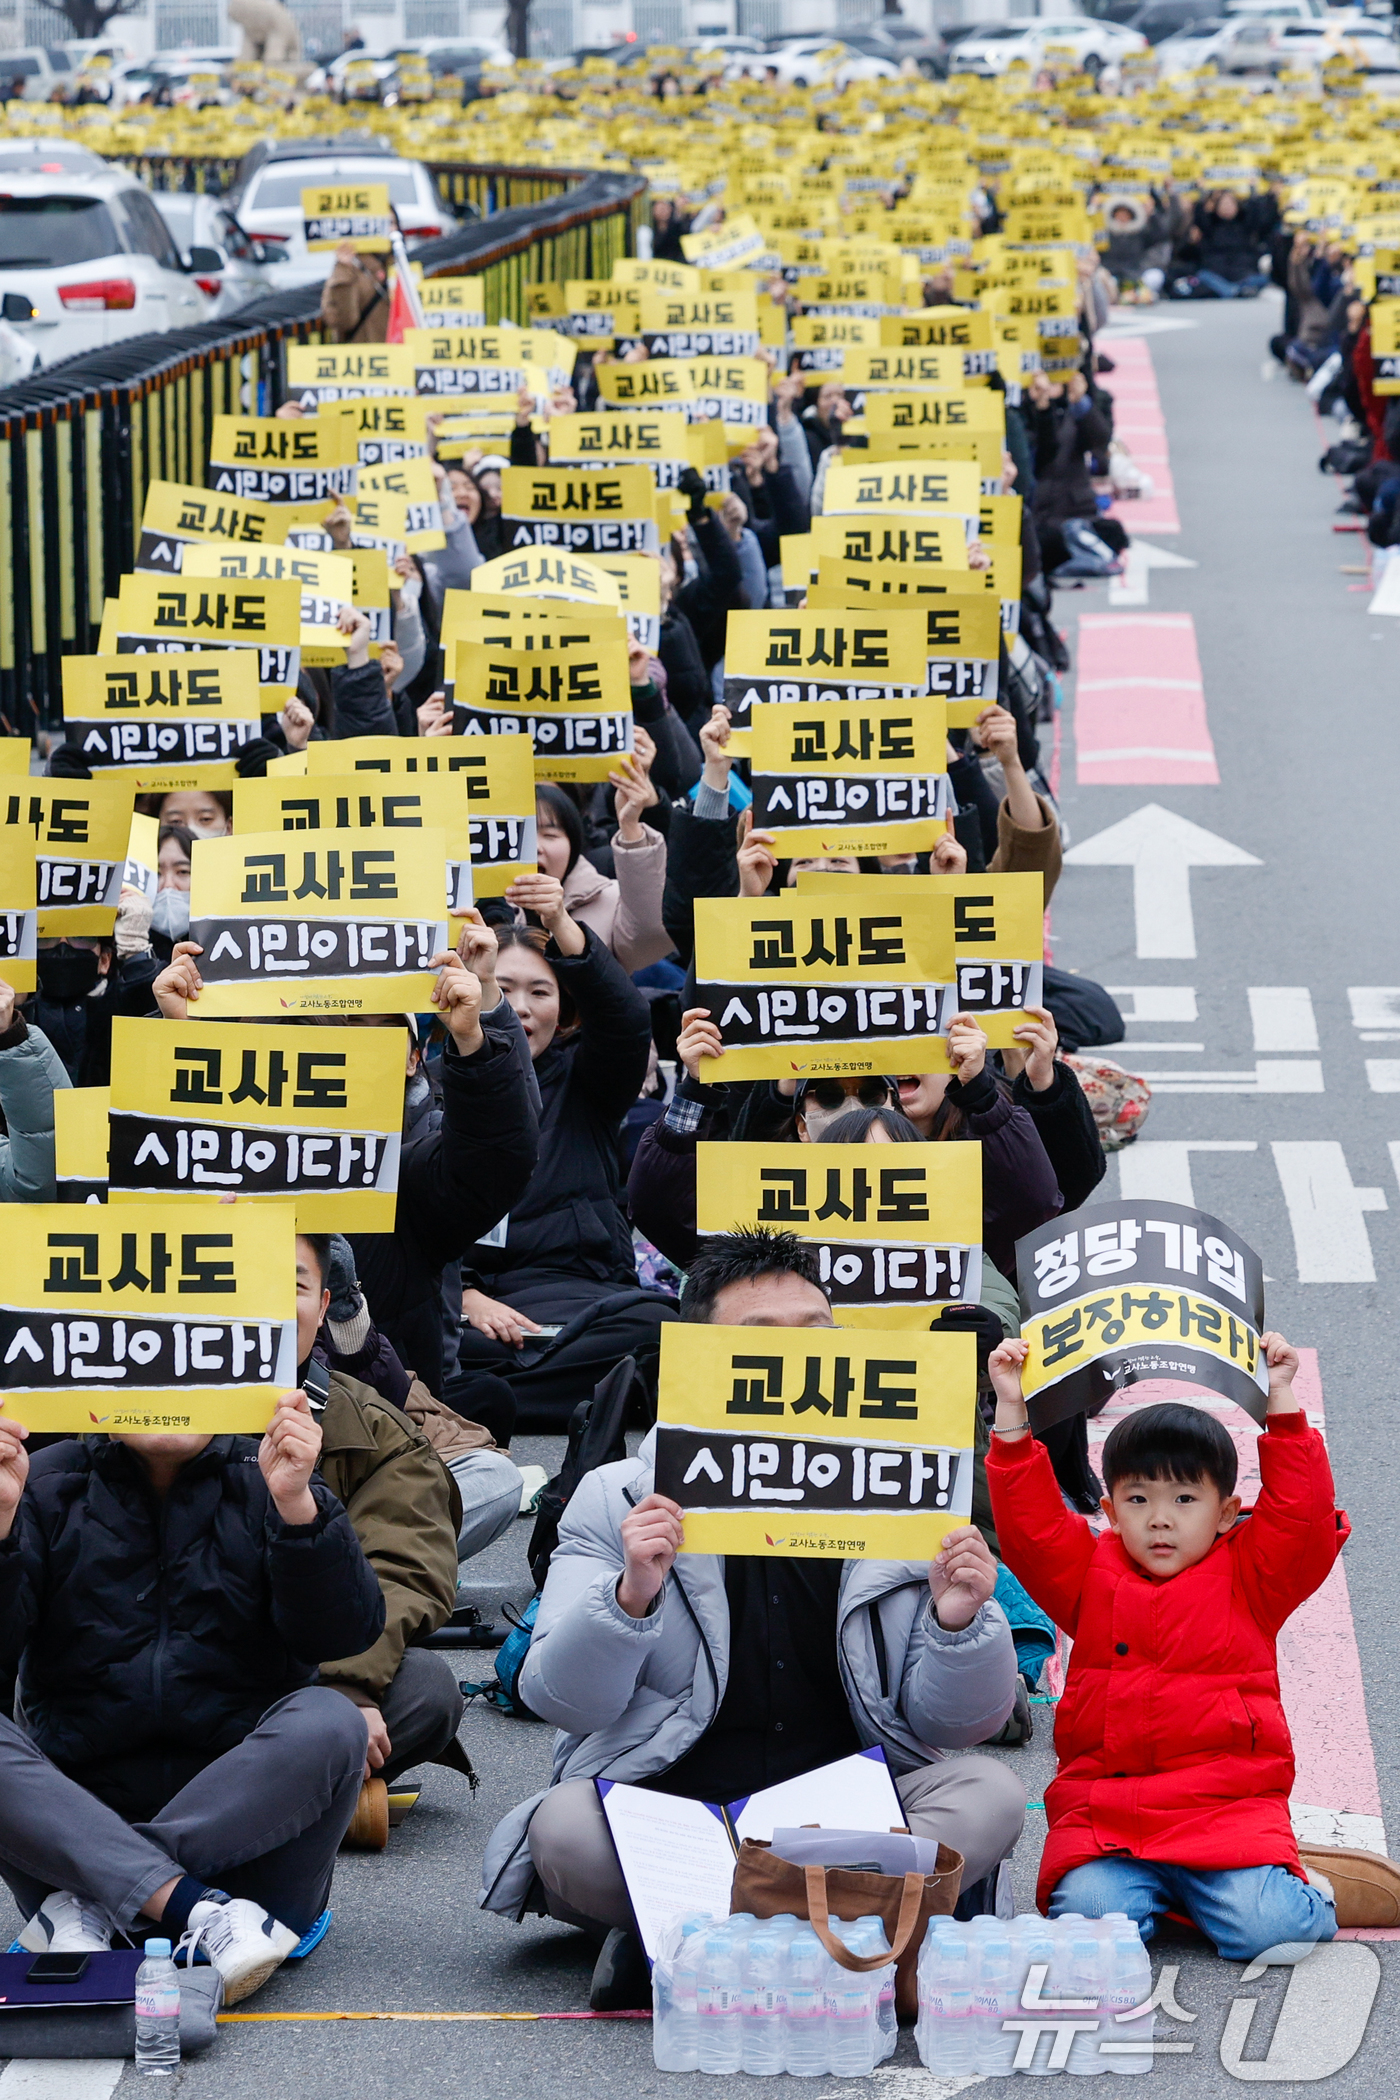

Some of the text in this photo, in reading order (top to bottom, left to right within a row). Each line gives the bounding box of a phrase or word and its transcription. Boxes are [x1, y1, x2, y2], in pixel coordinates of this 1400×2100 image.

[666, 303, 734, 325] 교사도
[902, 323, 971, 345] 교사도
[316, 356, 390, 378] 교사도
[432, 338, 500, 359] 교사도
[869, 357, 939, 380] 교사도
[615, 372, 680, 398] 교사도
[892, 401, 969, 426] 교사도
[233, 430, 319, 459] 교사도
[578, 424, 662, 451] 교사도
[530, 481, 623, 511] 교사도
[856, 474, 949, 503] 교사도
[177, 501, 266, 543] 교사도
[513, 523, 645, 551] 시민이다!
[842, 530, 943, 562] 교사도
[501, 558, 598, 593] 교사도
[154, 592, 266, 631] 교사도
[765, 627, 889, 668] 교사도
[104, 668, 223, 709] 교사도
[485, 662, 603, 702] 교사도
[83, 721, 247, 762] 시민이다!
[790, 717, 915, 762] 교사도
[766, 778, 937, 821] 시민이다!
[240, 850, 399, 903] 교사도
[208, 922, 431, 972] 시민이다!
[749, 916, 906, 969] 교사도
[719, 987, 938, 1036] 시민이다!
[169, 1046, 348, 1108] 교사도
[809, 1059, 873, 1072] 교사노동조합연맹
[133, 1128, 378, 1186] 시민이다!
[757, 1167, 930, 1223] 교사도
[43, 1232, 237, 1295] 교사도
[1032, 1219, 1246, 1302] 정당가입
[3, 1321, 273, 1380] 시민이다!
[1040, 1291, 1258, 1371] 보장하라!
[725, 1354, 919, 1420] 교사도
[1124, 1359, 1197, 1375] 교사노동조합연맹
[113, 1415, 191, 1427] 교사노동조합연맹
[682, 1441, 951, 1504] 시민이다!
[788, 1537, 867, 1551] 교사노동조합연맹
